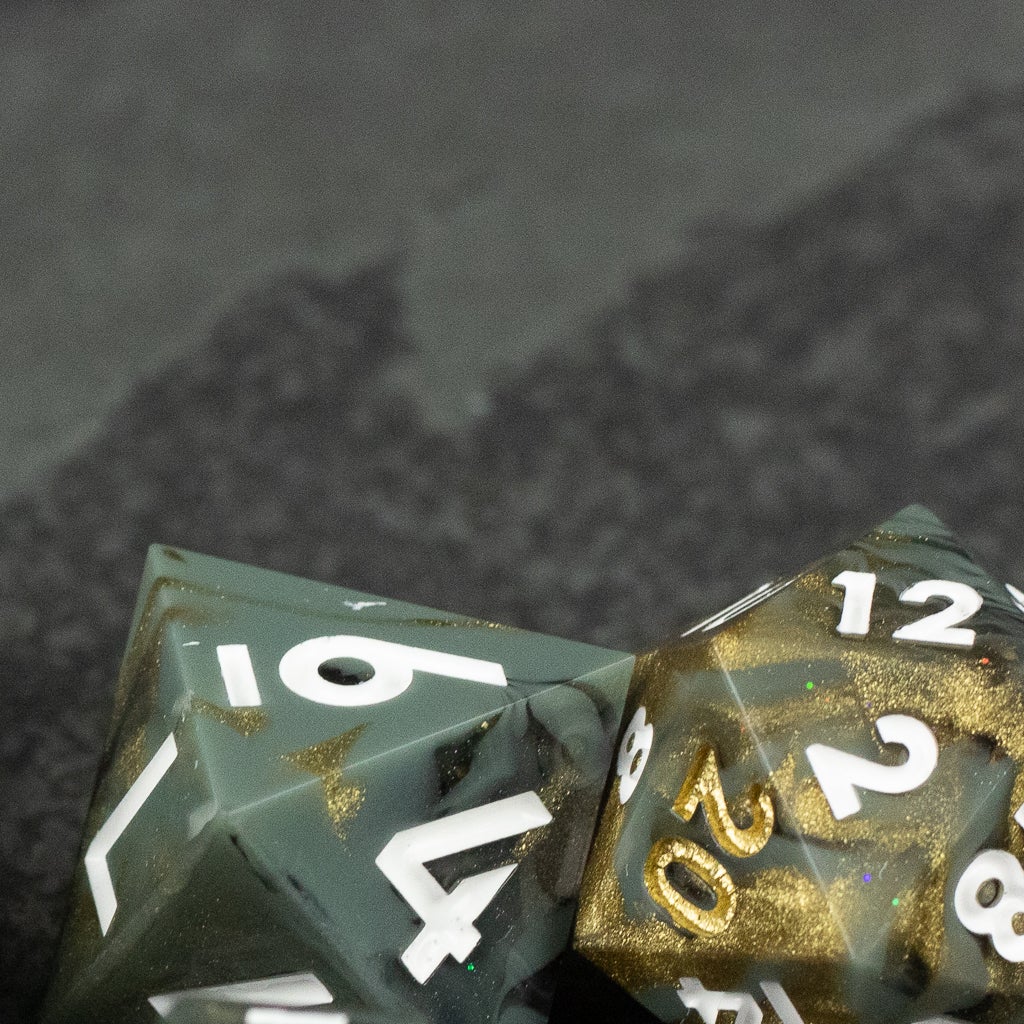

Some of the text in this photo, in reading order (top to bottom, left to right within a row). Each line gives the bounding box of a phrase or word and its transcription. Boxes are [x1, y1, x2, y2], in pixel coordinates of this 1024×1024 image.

[832, 570, 983, 649] 12
[644, 745, 775, 938] 20
[805, 713, 939, 821] 2
[375, 790, 554, 985] 4
